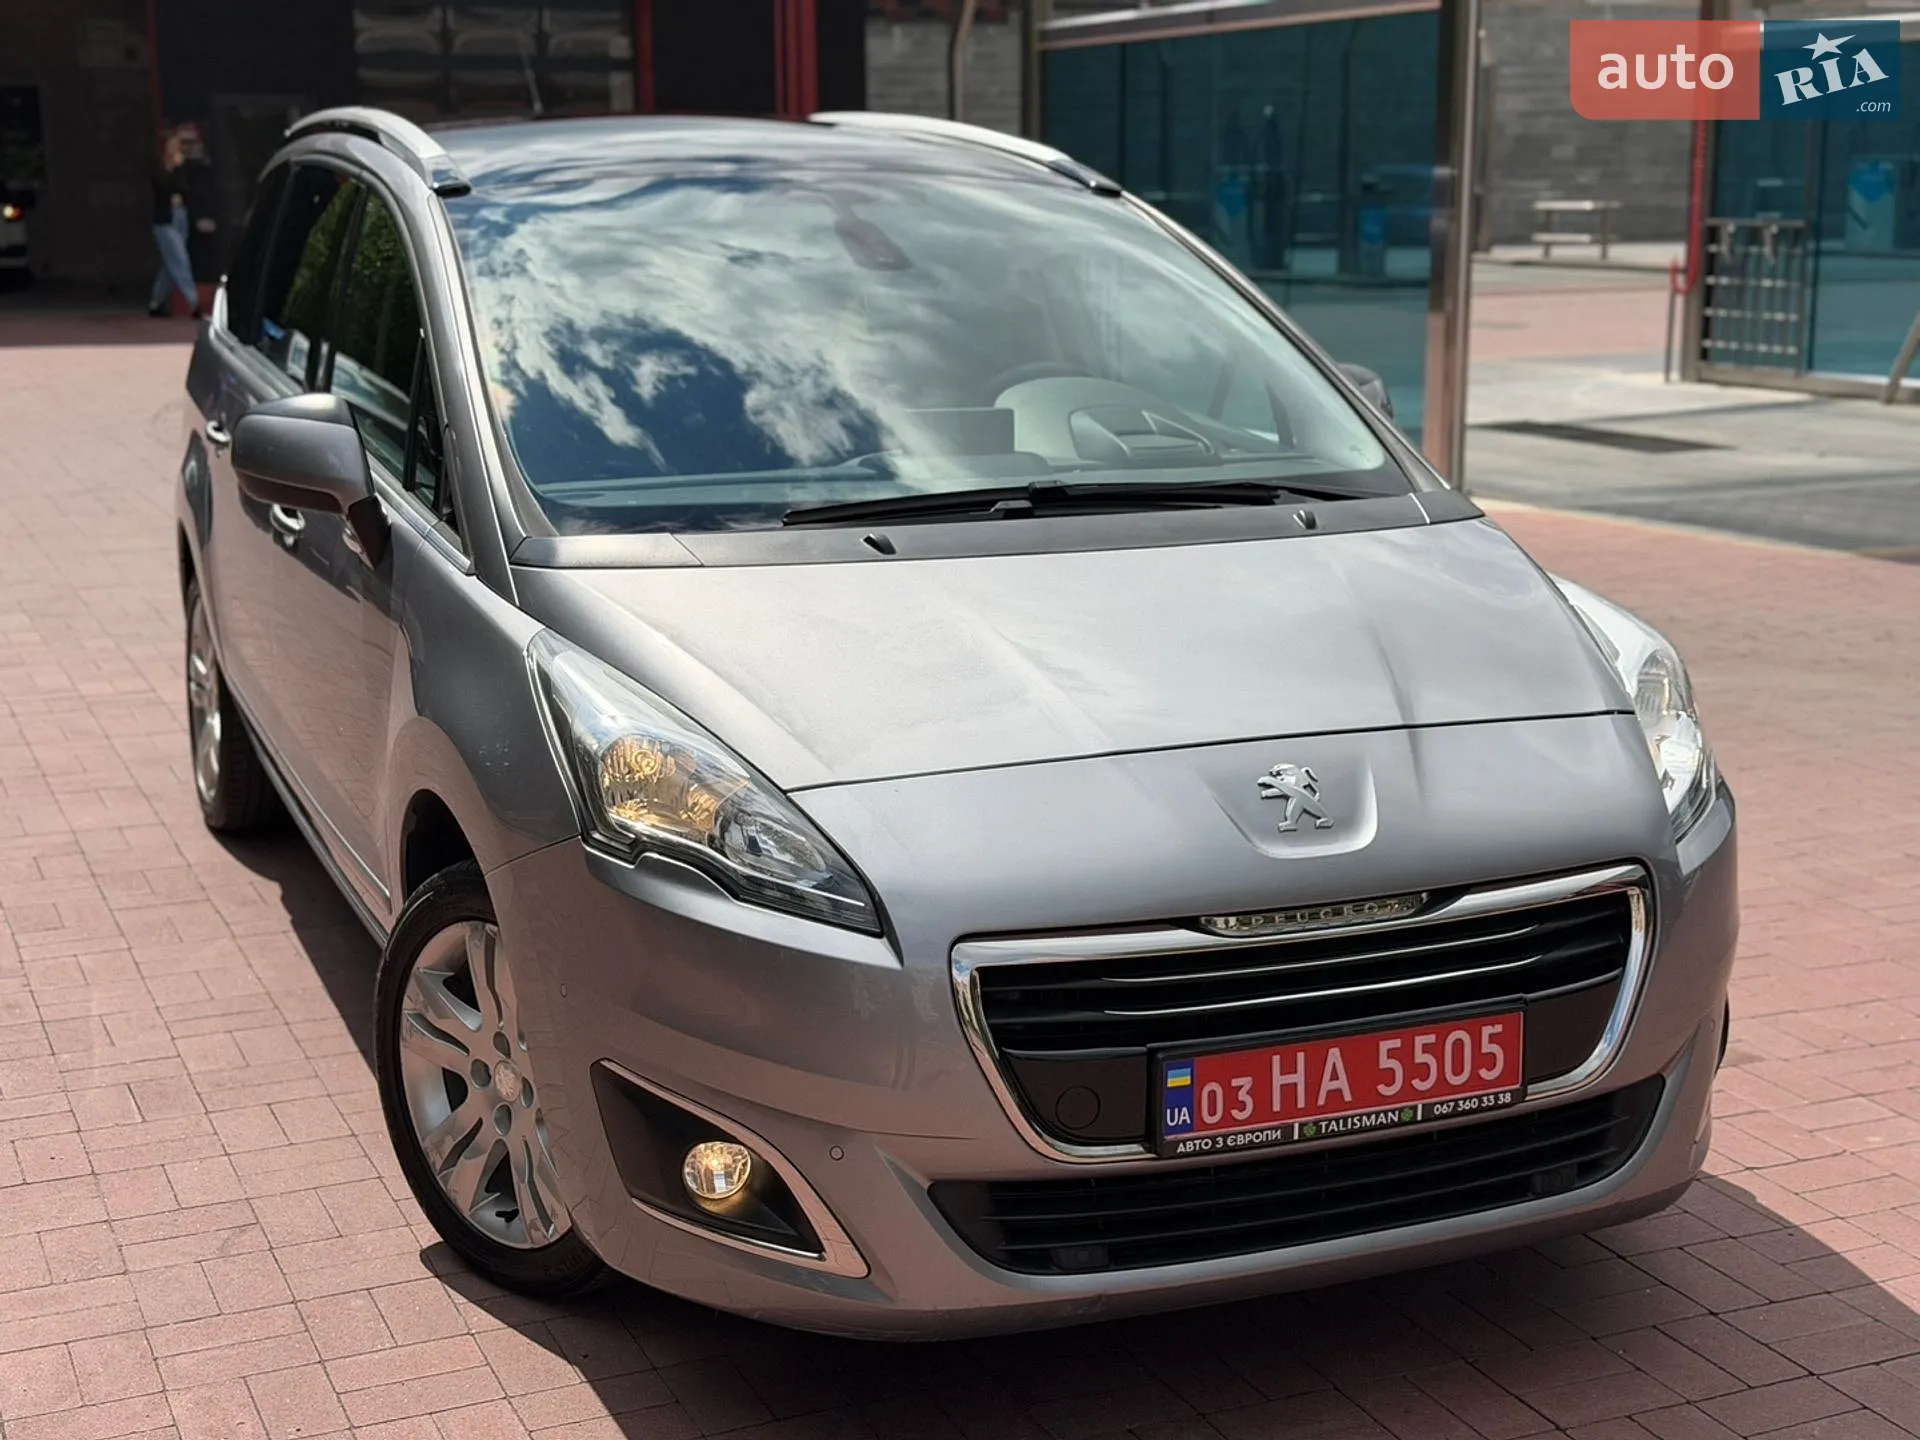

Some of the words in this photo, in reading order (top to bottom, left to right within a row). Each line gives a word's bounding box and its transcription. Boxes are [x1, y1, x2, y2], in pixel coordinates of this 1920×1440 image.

[1201, 1076, 1254, 1124] 03
[1271, 1047, 1352, 1112] HA
[1376, 1024, 1505, 1096] 5505
[1433, 1103, 1454, 1115] 067
[1457, 1098, 1479, 1112] 360
[1481, 1095, 1495, 1107] 33
[1497, 1092, 1512, 1104] 38
[1166, 1107, 1191, 1127] UA
[1319, 1110, 1400, 1134] TALISMAN
[1177, 1138, 1212, 1153] АВТО
[1227, 1129, 1281, 1146] ЄВРОПИ
